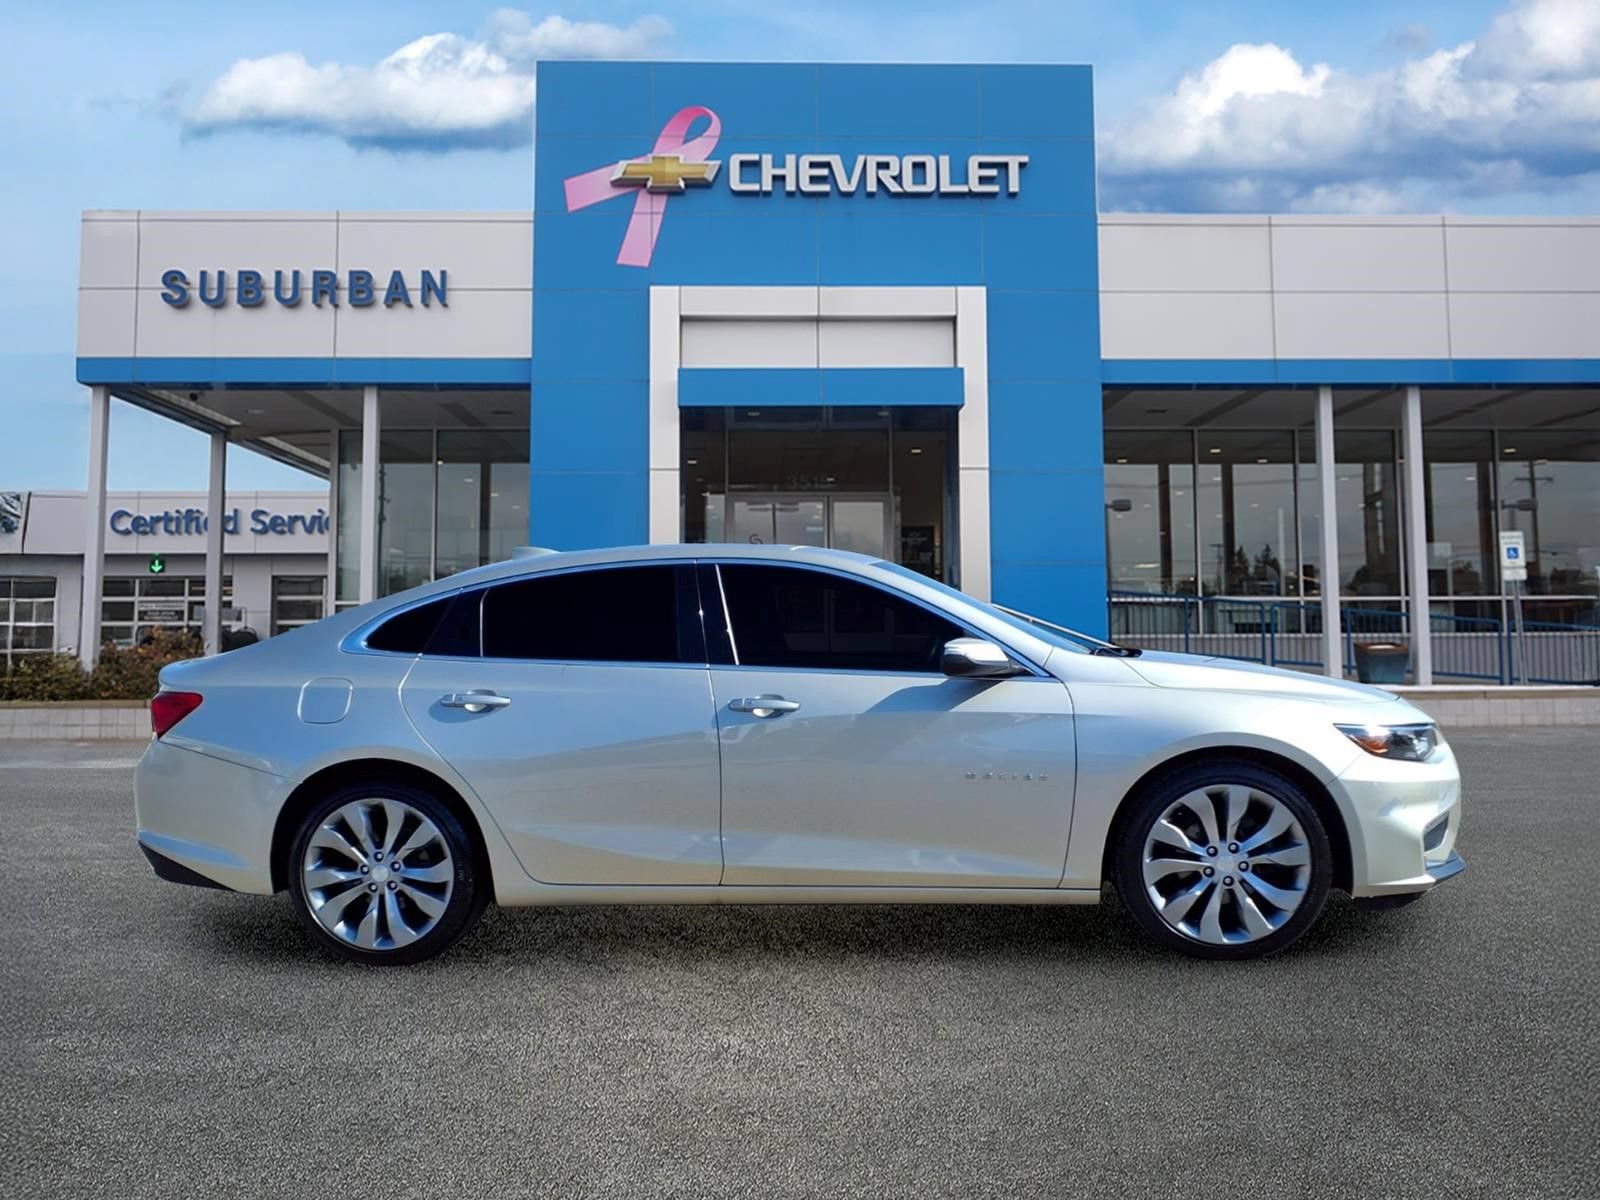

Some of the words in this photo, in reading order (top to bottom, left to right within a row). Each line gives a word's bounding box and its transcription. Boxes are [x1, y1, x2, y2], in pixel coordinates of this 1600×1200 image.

[729, 153, 1029, 195] CHEVROLET
[161, 269, 450, 308] SUBURBAN
[110, 508, 241, 536] Certifid
